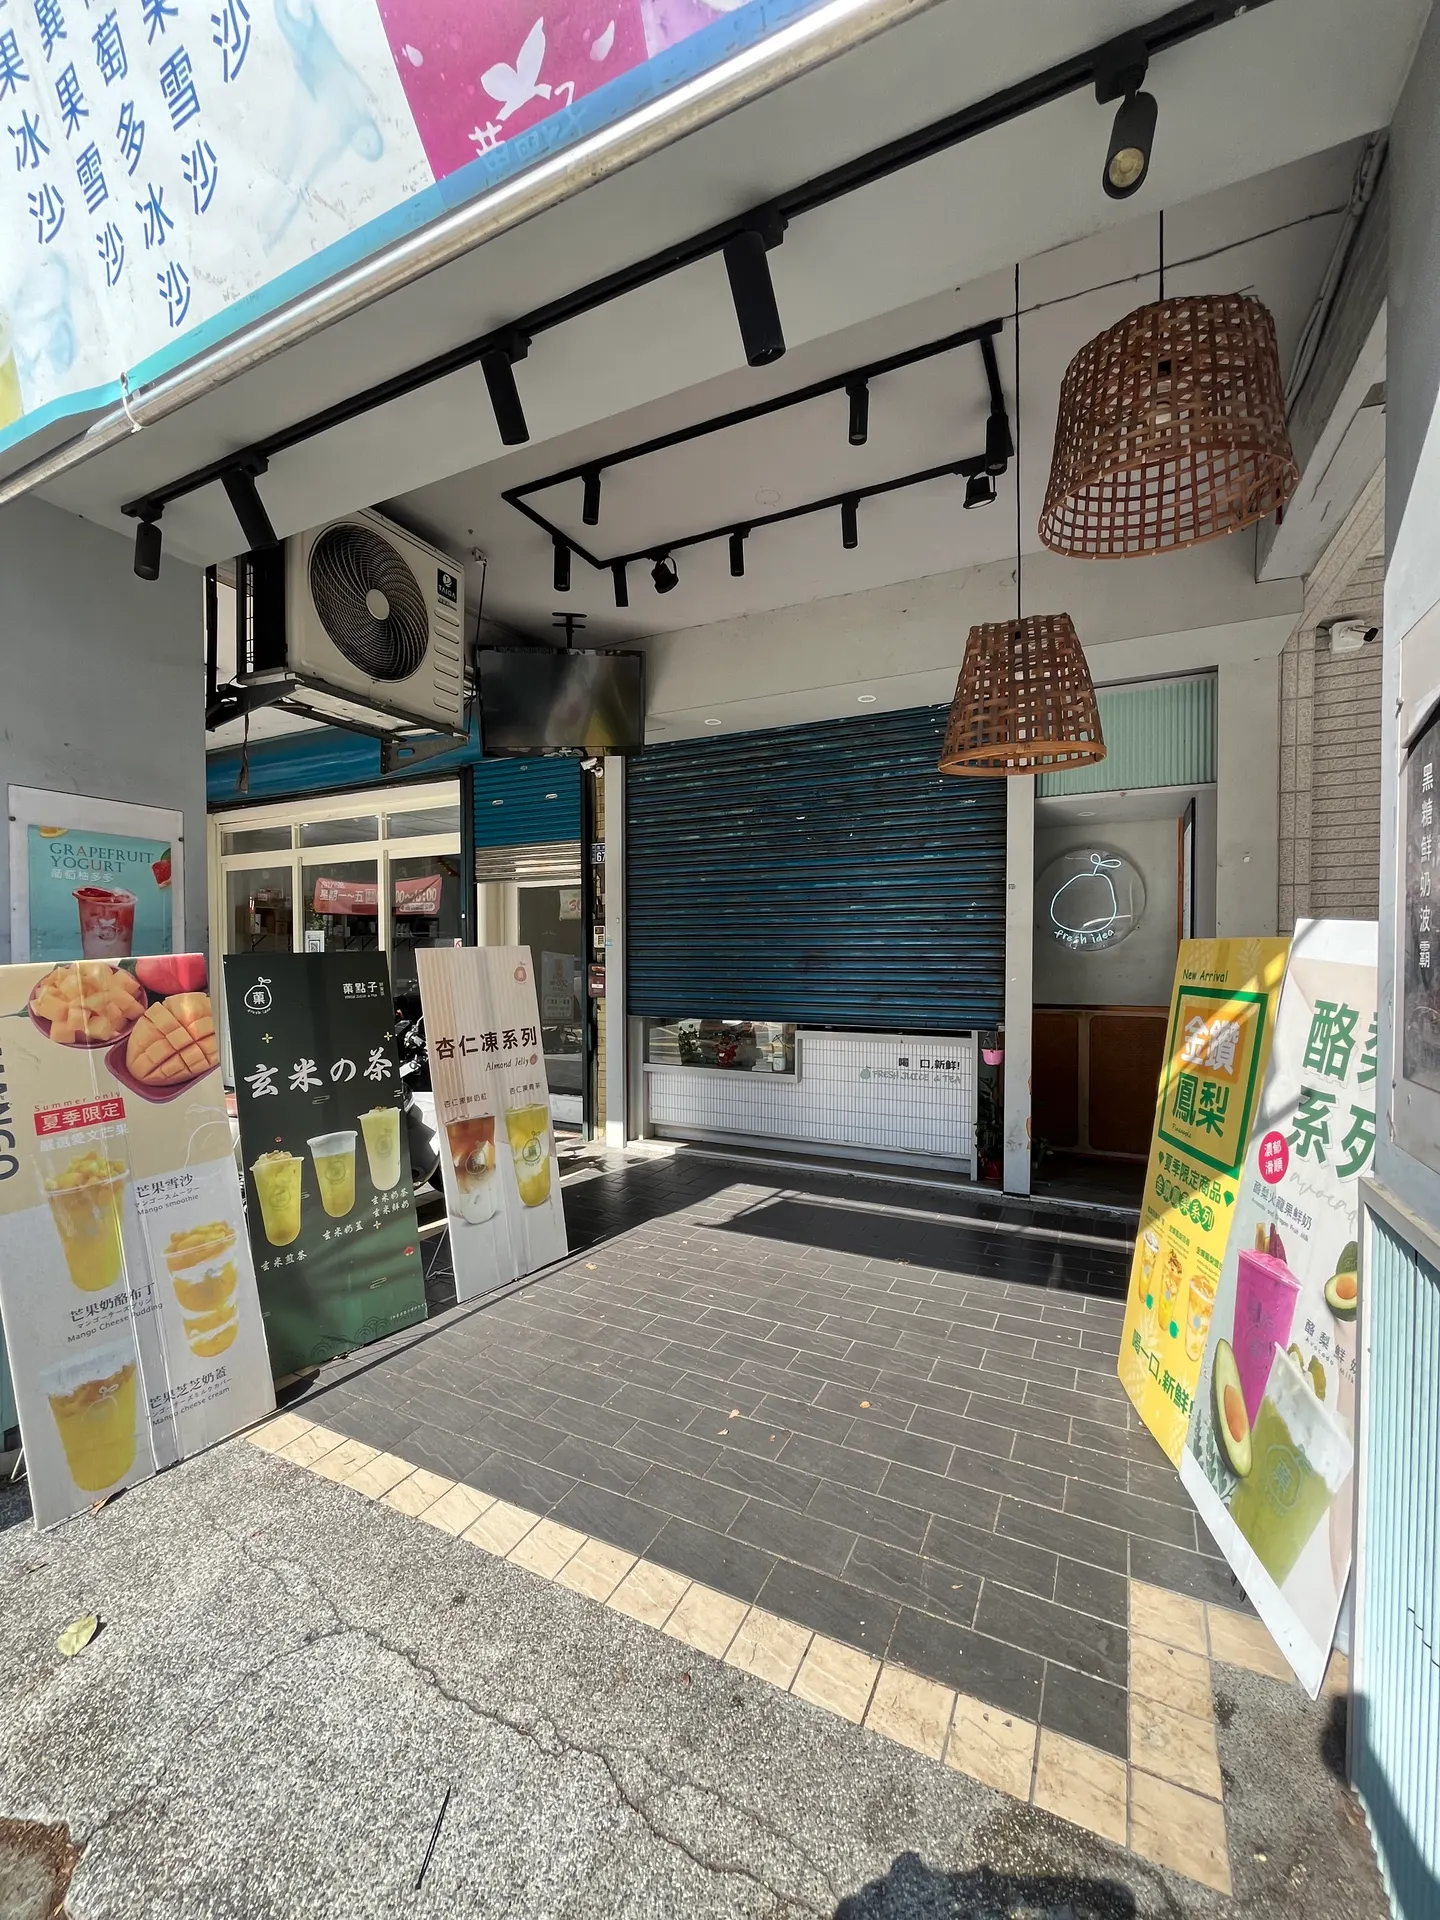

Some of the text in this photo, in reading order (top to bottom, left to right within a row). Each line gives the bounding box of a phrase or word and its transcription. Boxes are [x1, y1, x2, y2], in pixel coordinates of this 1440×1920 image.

[0, 0, 65, 244] 果冰沙
[84, 0, 190, 327] 萄多冰沙
[438, 584, 456, 600] TAIGA
[49, 842, 154, 864] GRAPEFRUIT
[50, 855, 125, 873] YOGURT
[1418, 762, 1434, 968] 黑糖鮮奶波霸
[1054, 929, 1115, 945] fresh idea
[1182, 969, 1229, 983] New Arrival
[435, 1025, 538, 1060] 杏仁凍系列
[243, 1046, 393, 1099] 玄米の茶
[485, 1057, 530, 1071] Almond Jelly
[34, 1091, 121, 1112] Summer only
[1172, 1071, 1230, 1138] 鳳梨
[40, 1102, 120, 1132] 夏季限定
[1163, 1152, 1223, 1205] 夏季限定商品
[137, 1194, 199, 1216] Mango smoothie
[67, 1327, 97, 1343] Mango
[99, 1315, 129, 1331] Cheese
[152, 1386, 230, 1427] Mango cheese cream
